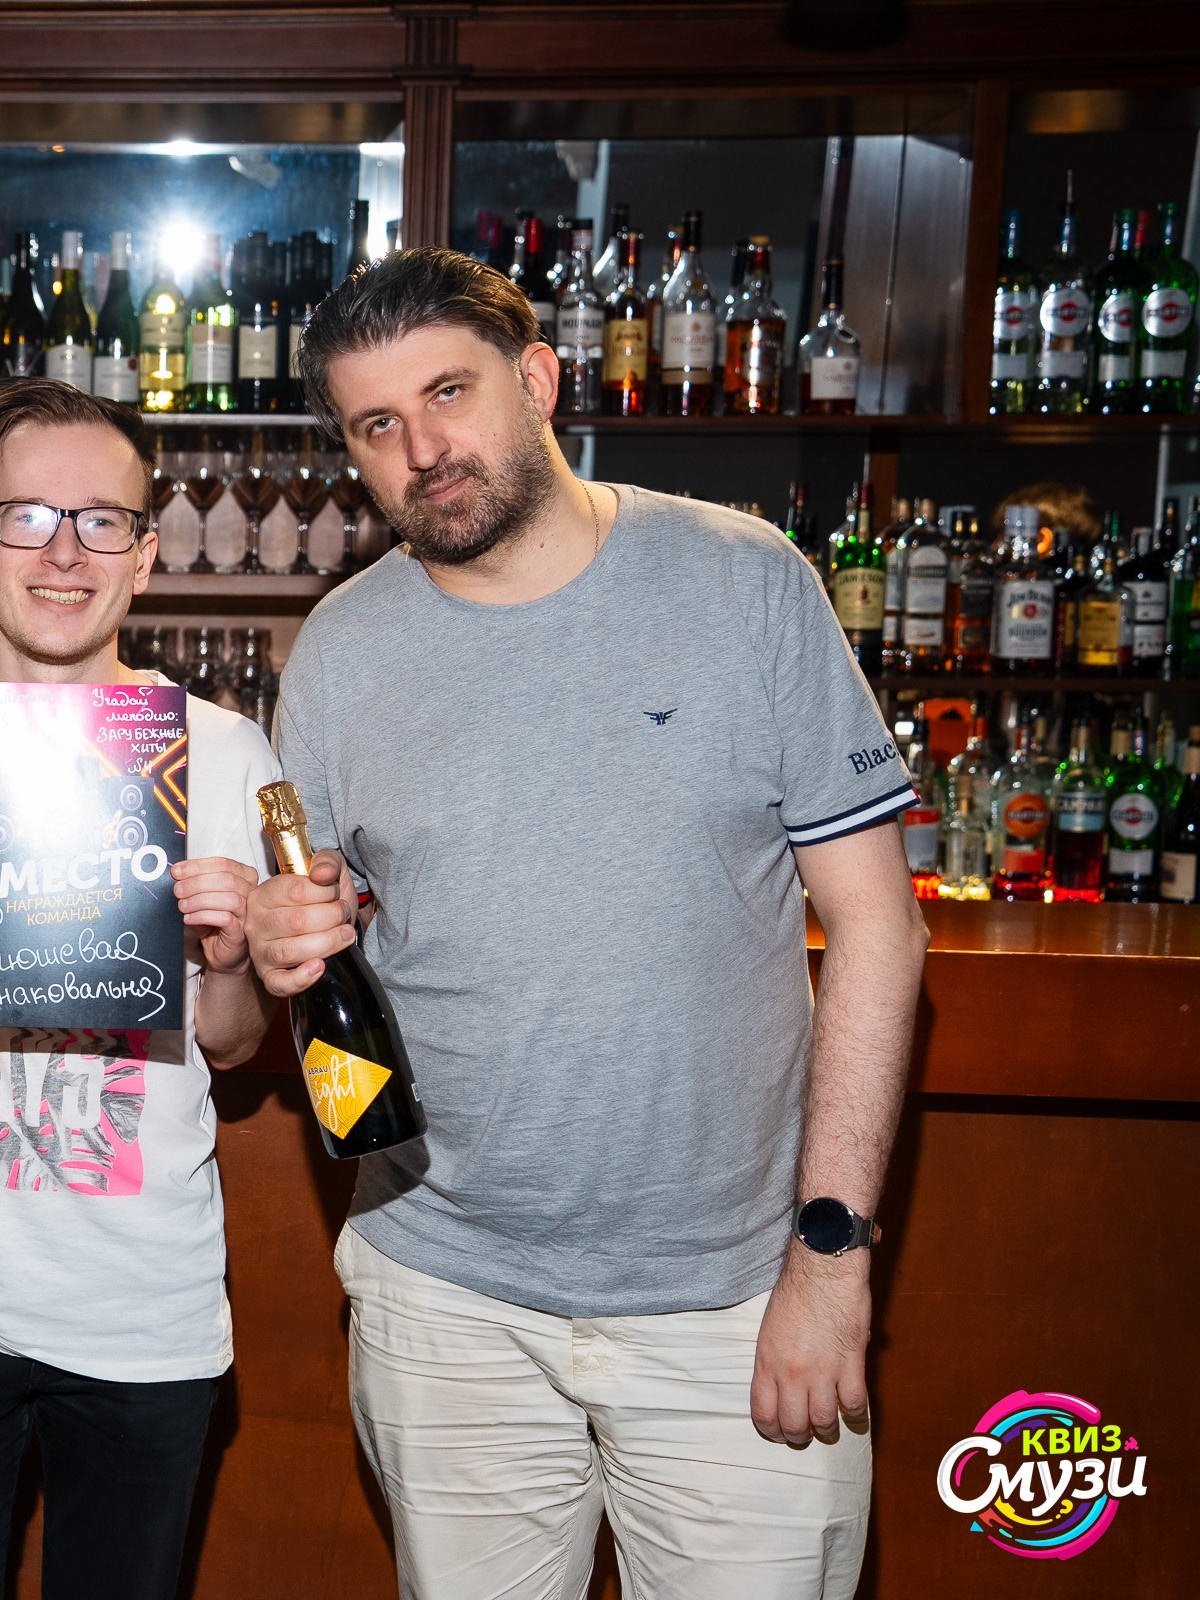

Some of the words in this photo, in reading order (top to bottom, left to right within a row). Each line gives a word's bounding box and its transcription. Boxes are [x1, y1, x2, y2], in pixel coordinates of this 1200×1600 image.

[92, 686, 154, 707] Угадай
[847, 738, 899, 775] Blac
[6, 888, 123, 913] НАГРАЖДАЕТСЯ
[26, 907, 102, 926] КОМАНДА
